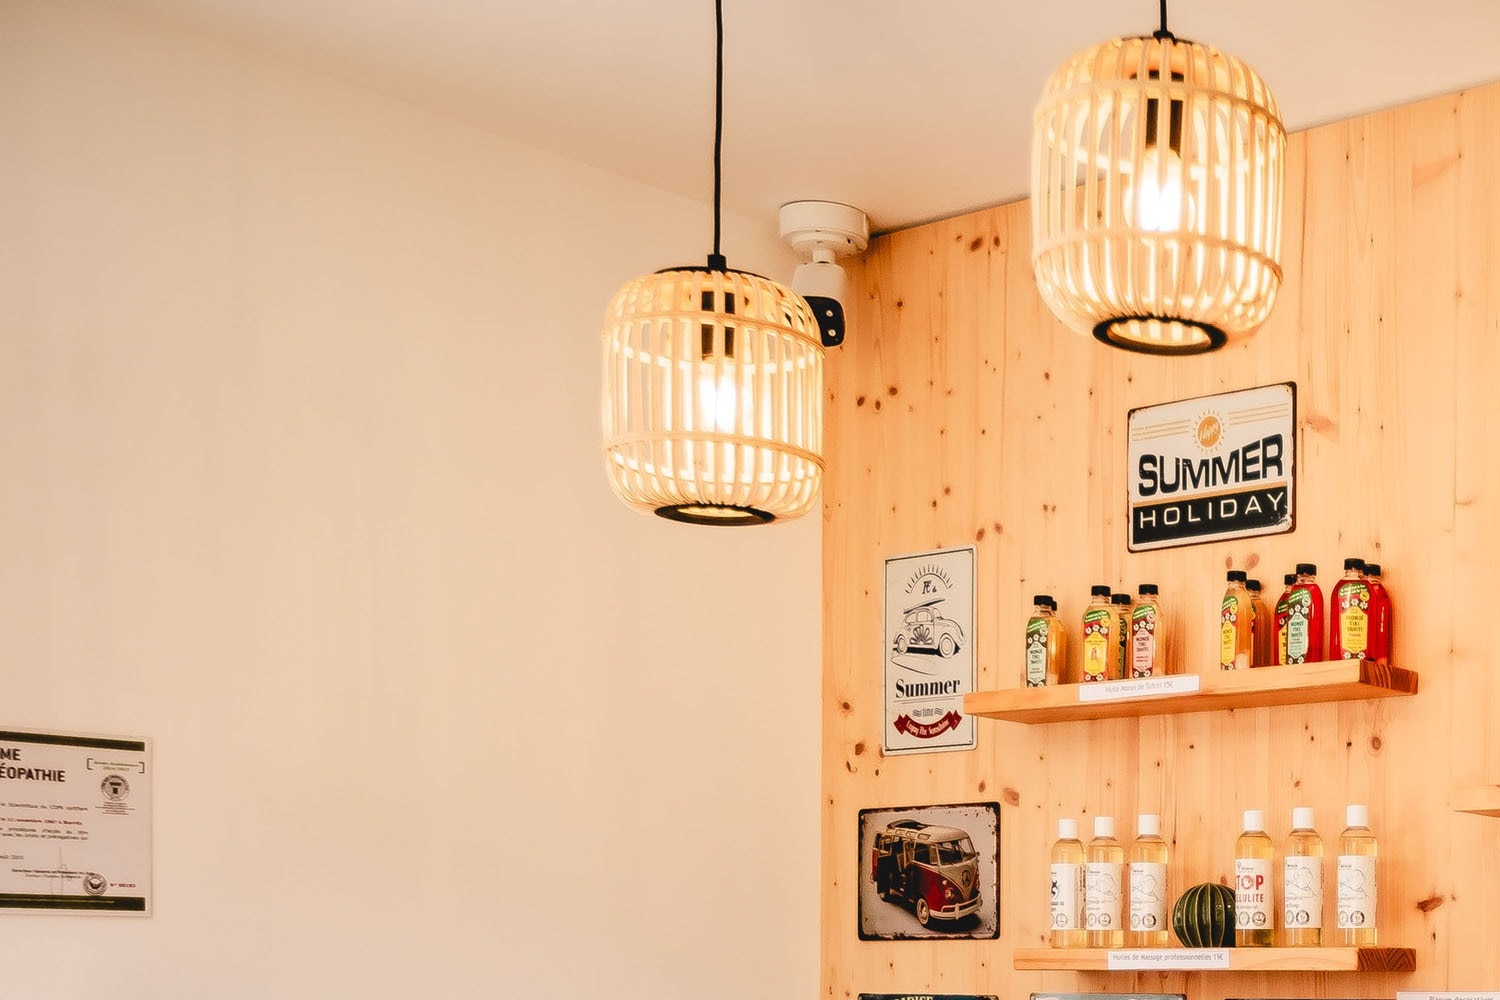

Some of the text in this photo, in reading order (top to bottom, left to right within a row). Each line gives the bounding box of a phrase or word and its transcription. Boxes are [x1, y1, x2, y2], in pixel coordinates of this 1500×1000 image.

[1138, 433, 1283, 497] SUMMER
[1139, 491, 1284, 529] HOLIDAY
[895, 678, 960, 699] Summer
[0, 762, 66, 782] ÉOPATHIE
